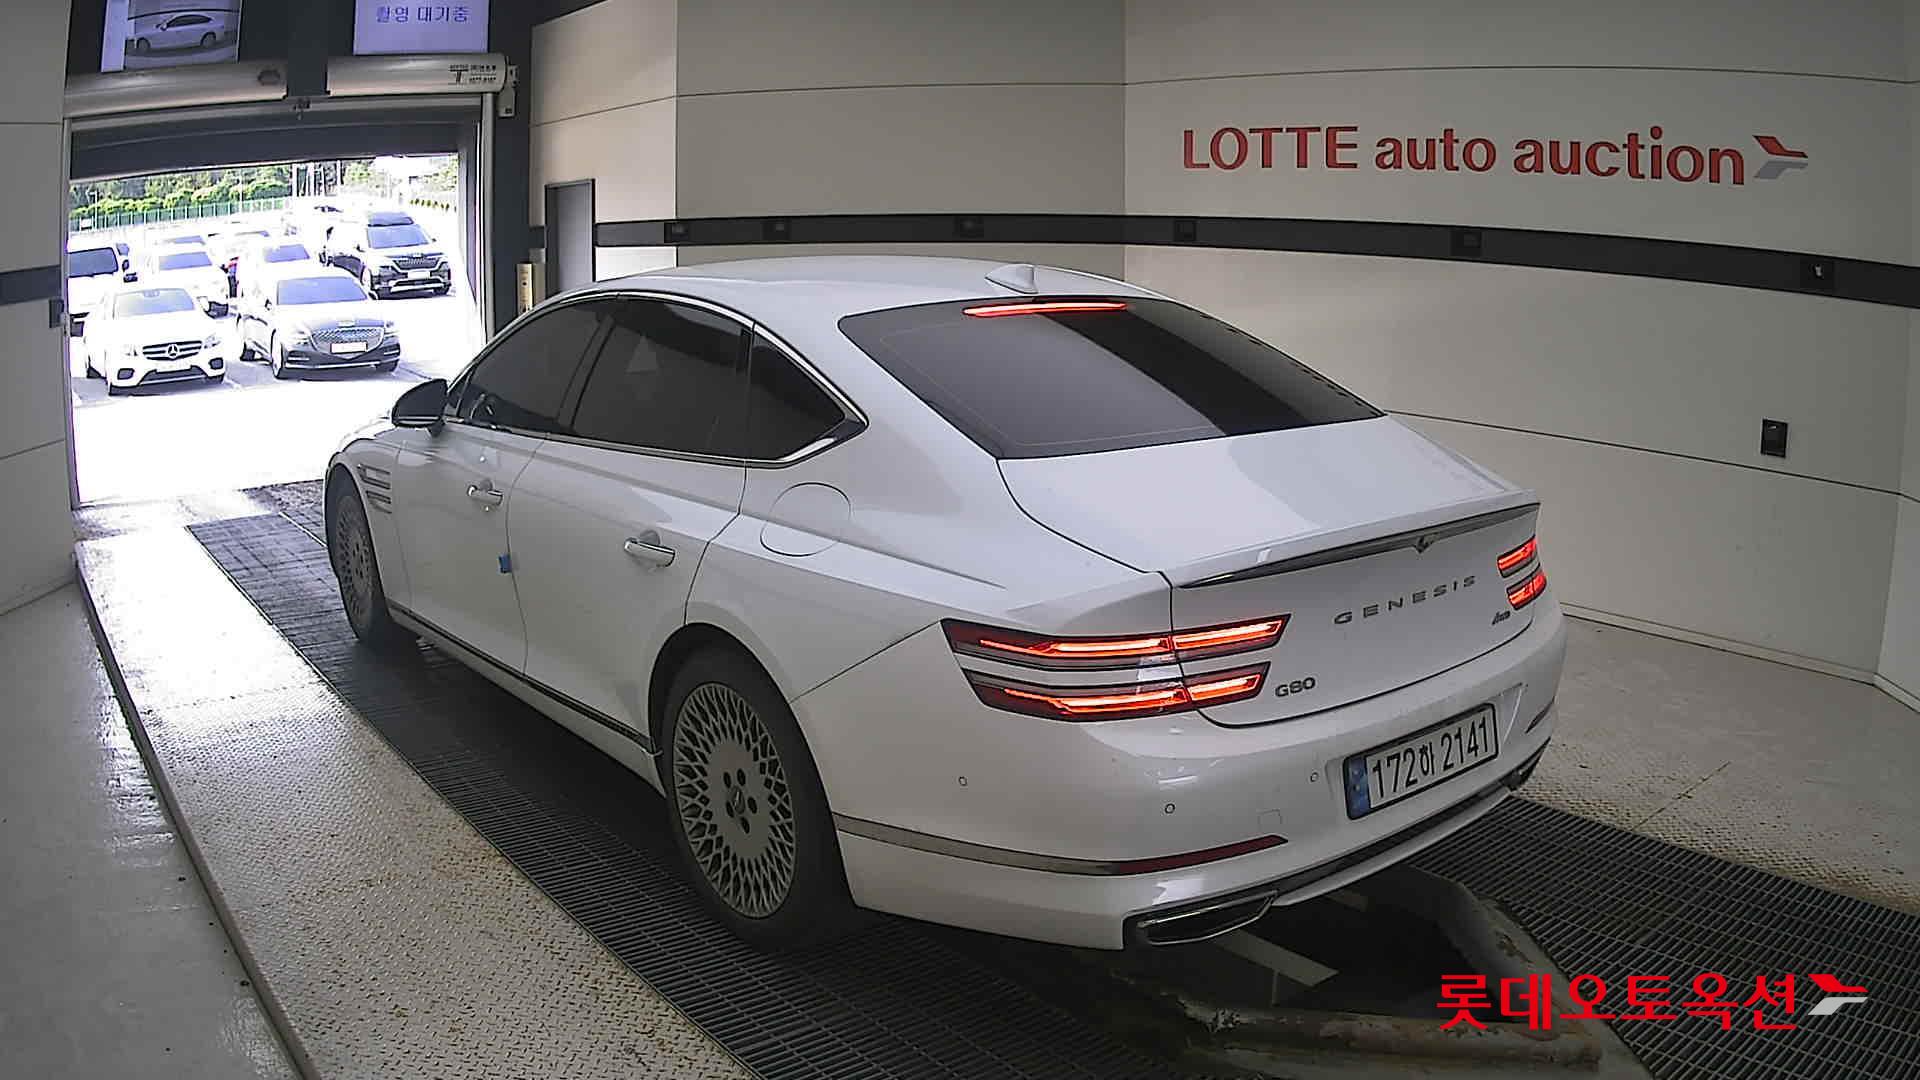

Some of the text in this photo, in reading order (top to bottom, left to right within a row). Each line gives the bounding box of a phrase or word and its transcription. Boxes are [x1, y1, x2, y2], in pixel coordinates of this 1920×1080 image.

[417, 6, 467, 22] 대기중
[1183, 126, 1744, 185] LOTTE auto auction
[1334, 575, 1476, 624] GENESIS
[1275, 677, 1315, 697] G80
[1372, 716, 1488, 798] 172하 2141
